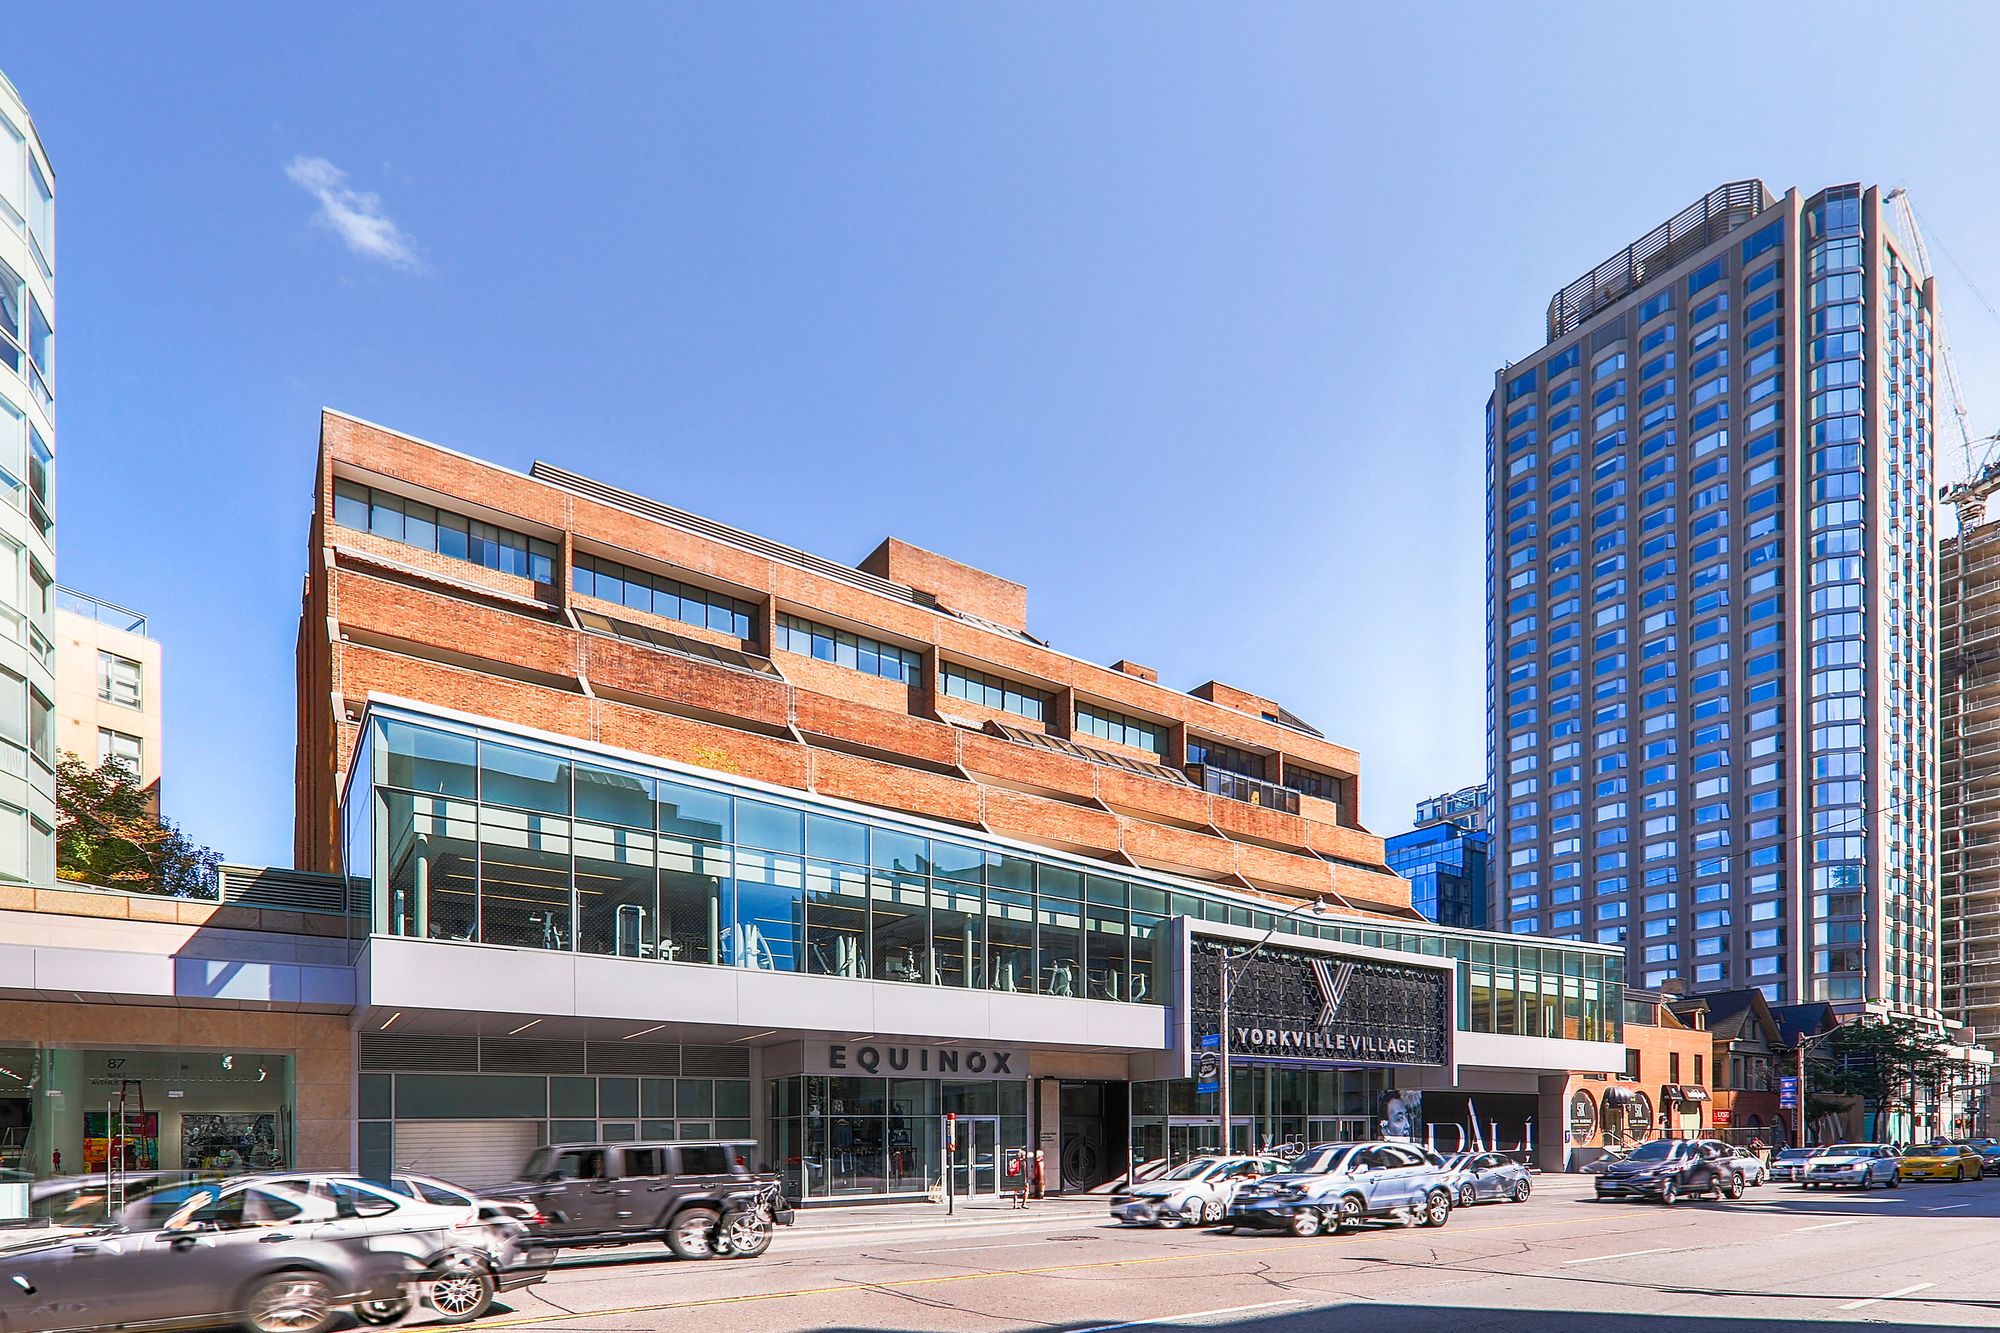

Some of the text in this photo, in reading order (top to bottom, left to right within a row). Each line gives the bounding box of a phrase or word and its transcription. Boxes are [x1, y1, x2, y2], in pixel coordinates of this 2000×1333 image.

[1237, 1027, 1416, 1054] YORKVILLE VILLAGE
[107, 1058, 126, 1069] 87
[829, 1045, 1012, 1075] EQUINOX
[1285, 1134, 1305, 1154] 55
